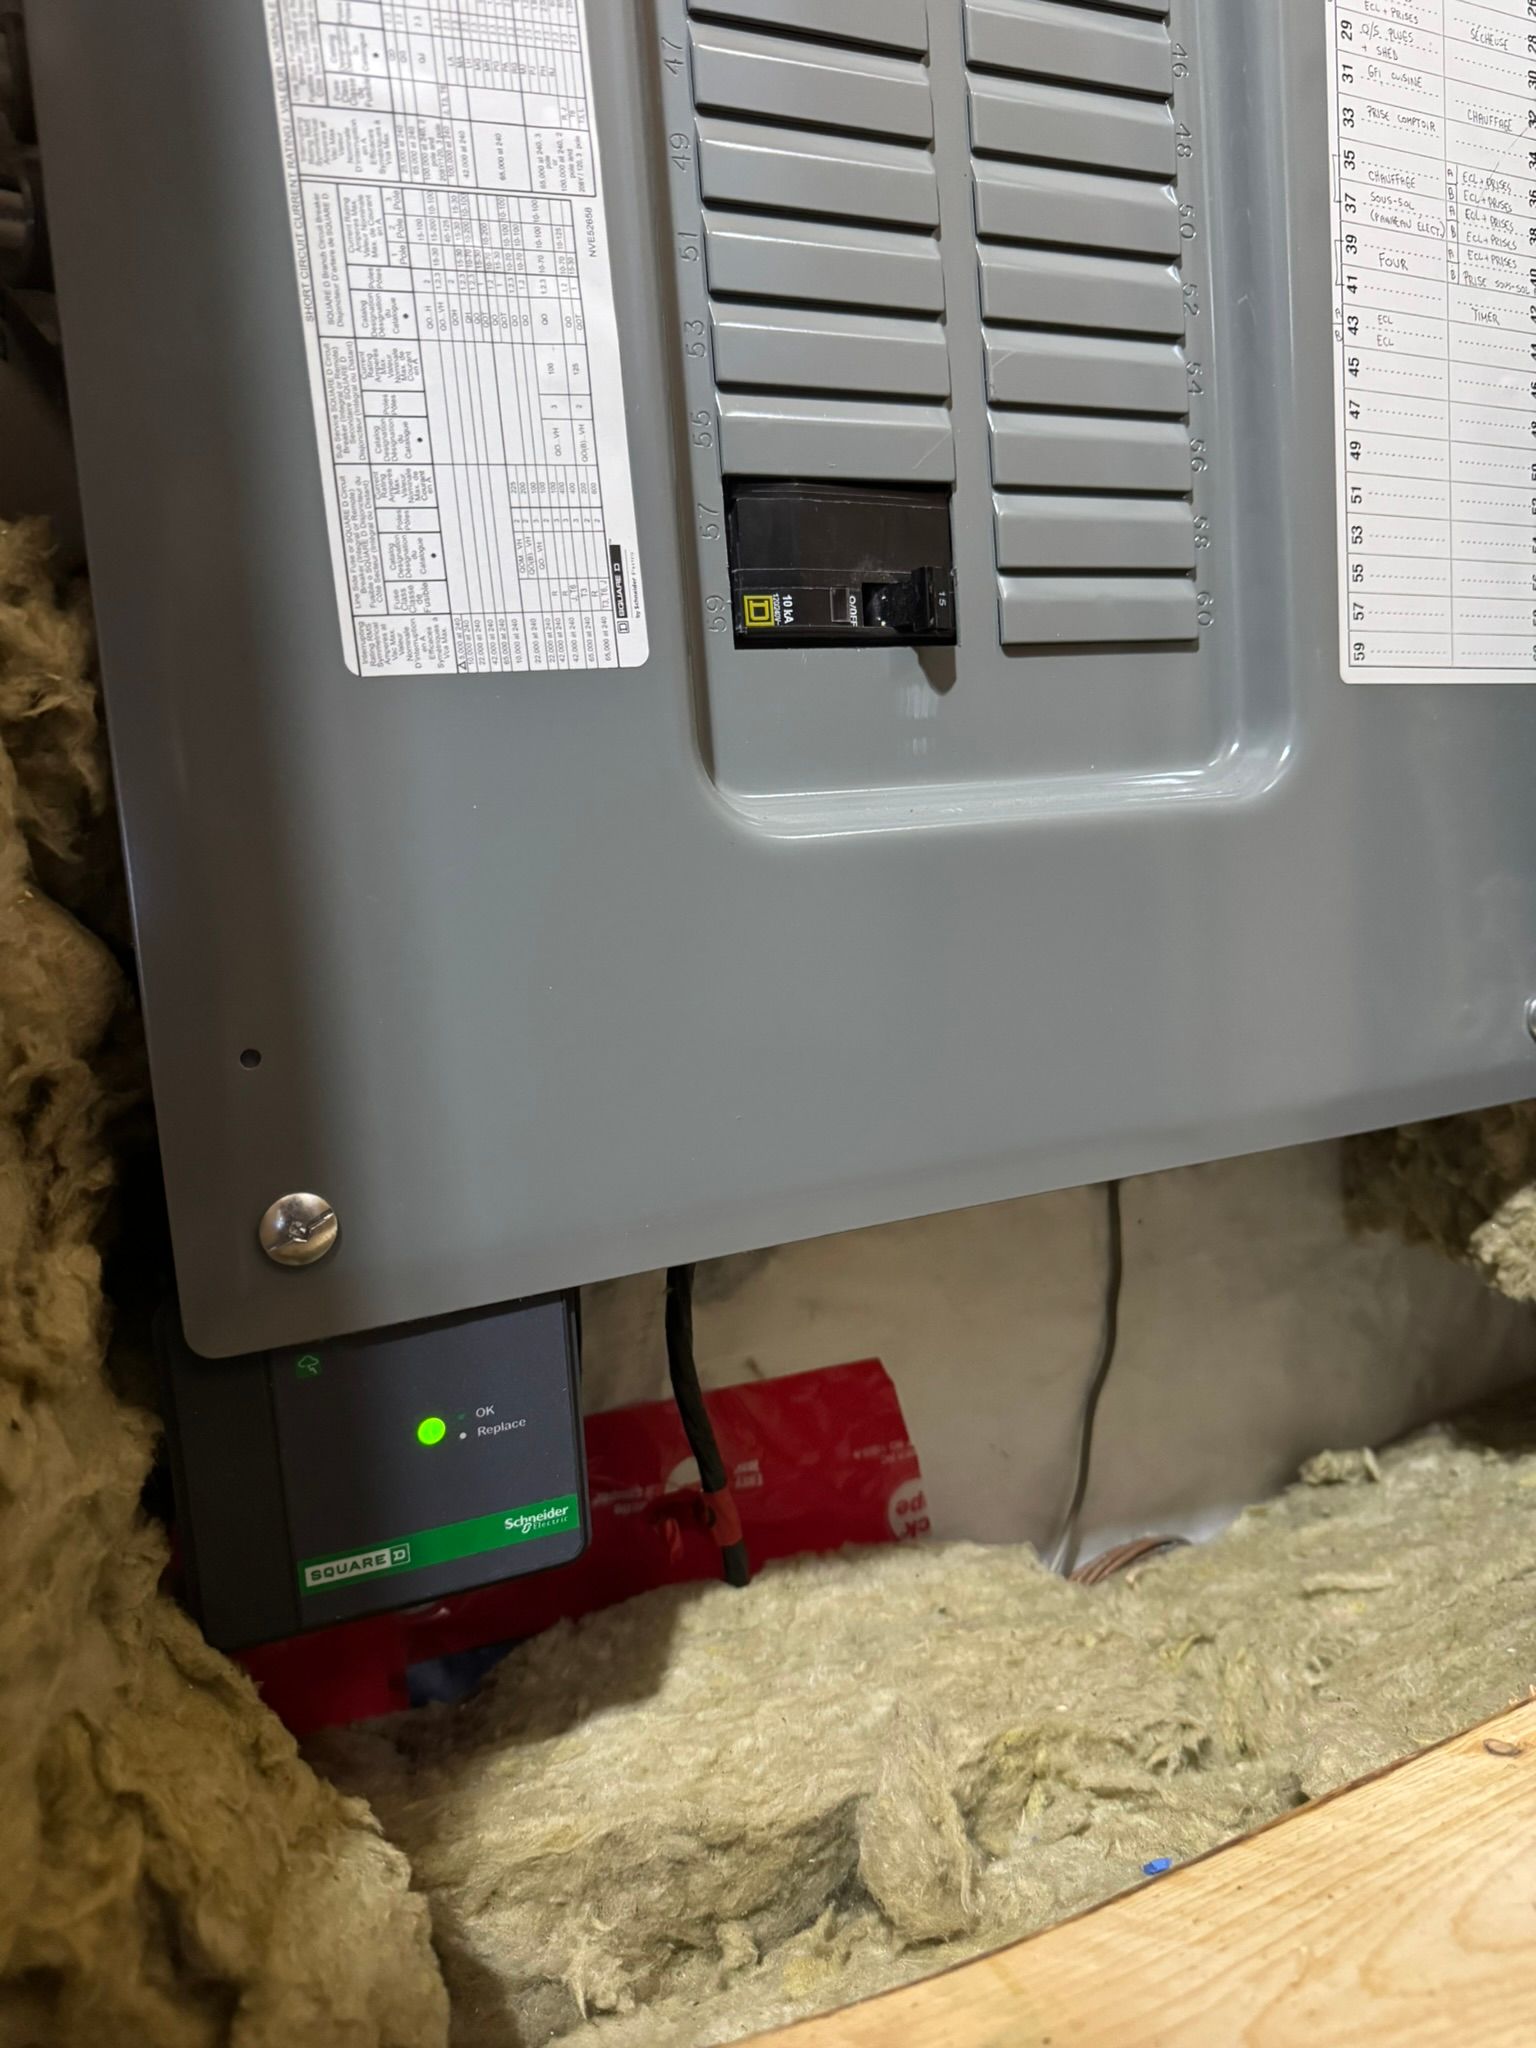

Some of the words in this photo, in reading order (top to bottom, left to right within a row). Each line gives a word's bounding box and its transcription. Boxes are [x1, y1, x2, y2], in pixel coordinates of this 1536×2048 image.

[1391, 7, 1418, 24] PRISES
[1341, 20, 1352, 41] 29
[661, 36, 684, 75] 47
[1342, 64, 1353, 83] 31
[1391, 72, 1422, 88] CUISINE
[1343, 107, 1354, 127] 33
[1367, 105, 1390, 121] PRISE
[1397, 115, 1436, 131] COMPTOIR
[283, 121, 295, 169] RATING
[669, 132, 691, 172] 49
[1344, 150, 1355, 170] 35
[287, 173, 304, 230] CURRENT
[313, 192, 324, 223] Breaker
[1345, 193, 1356, 213] 37
[1370, 192, 1414, 210] SOUS-SOL
[317, 225, 326, 249] Circuit
[677, 232, 700, 262] 51
[1345, 234, 1357, 254] 39
[295, 233, 310, 279] CIRCUIT
[319, 251, 329, 279] Branch
[1379, 252, 1408, 271] FOUR
[1347, 275, 1358, 294] 41
[301, 282, 314, 322] SHORT
[324, 290, 335, 325] SQUARE
[1347, 316, 1359, 335] 43
[1378, 315, 1393, 325] ECL
[1471, 307, 1500, 325] TIMER
[684, 320, 708, 358] 53
[1377, 335, 1394, 346] ECL
[1348, 357, 1359, 377] 45
[1349, 400, 1360, 419] 47
[690, 411, 713, 448] 55
[1350, 441, 1361, 460] 49
[1351, 486, 1362, 504] 51
[697, 503, 721, 541] 57
[1351, 525, 1363, 544] 53
[416, 537, 427, 575] Catalogue
[1352, 564, 1363, 582] 55
[393, 589, 401, 610] Fuse
[614, 575, 625, 616] SQUARE
[631, 578, 640, 610] Schneider
[782, 594, 793, 607] 10
[939, 591, 946, 607] 15
[705, 595, 727, 633] 59
[784, 609, 794, 624] kA
[1353, 602, 1364, 621] 57
[1354, 642, 1365, 661] 59
[475, 1405, 495, 1418] OK
[477, 1418, 527, 1436] Replace
[504, 1506, 569, 1530] Schneider
[311, 1553, 387, 1581] SQUARE
[392, 1549, 406, 1561] D
